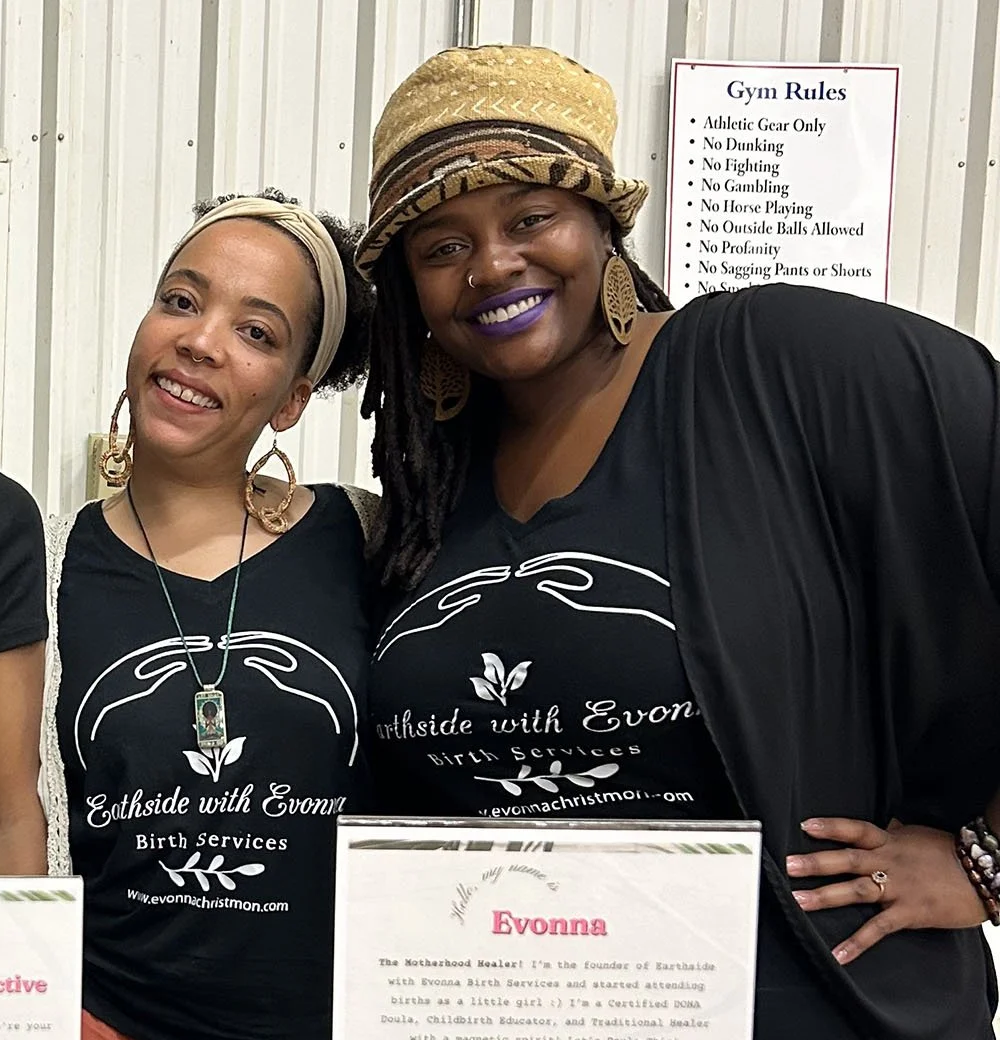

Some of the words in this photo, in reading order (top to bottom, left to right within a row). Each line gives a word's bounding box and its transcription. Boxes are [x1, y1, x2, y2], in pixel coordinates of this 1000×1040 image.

[726, 81, 777, 105] Gym
[784, 82, 847, 101] Rules
[703, 115, 754, 131] Athletic
[757, 118, 790, 132] Gear
[792, 118, 826, 137] Only
[703, 137, 723, 150] No
[726, 137, 785, 156] Dunking
[702, 157, 722, 171] No
[725, 158, 780, 177] Fighting
[701, 178, 721, 192] No
[724, 178, 790, 198] Gambling
[700, 199, 720, 212] No
[723, 199, 762, 213] Horse
[765, 201, 814, 219] Playing
[700, 220, 719, 233] No
[722, 220, 773, 234] Outside
[776, 221, 808, 235] Balls
[811, 222, 864, 236] Allowed
[699, 240, 718, 253] No
[721, 240, 781, 259] Profanity
[698, 261, 718, 274] No
[720, 262, 772, 280] Sagging
[774, 262, 809, 276] Pants
[812, 267, 828, 276] or
[830, 263, 872, 277] Shorts
[697, 281, 716, 293] No
[490, 704, 563, 734] with
[582, 700, 699, 733] Evon
[427, 749, 500, 767] Birth
[511, 744, 641, 761] Services
[199, 783, 254, 814] with
[135, 832, 188, 850] Birth
[196, 832, 288, 850] Services
[491, 911, 609, 936] Evonna
[378, 959, 399, 967] The
[404, 958, 472, 968] Motherhood
[477, 959, 523, 969] Healer!
[531, 960, 551, 969] I'm
[557, 961, 577, 969] the
[584, 961, 629, 970] founder
[635, 961, 649, 970] of
[655, 962, 716, 971] Earthside
[387, 977, 416, 986] with
[421, 977, 462, 987] Evonna
[466, 978, 502, 988] Birth
[506, 979, 560, 988] Services
[566, 979, 587, 989] and
[592, 981, 640, 989] started
[644, 982, 706, 992] attending
[26, 1023, 52, 1032] your
